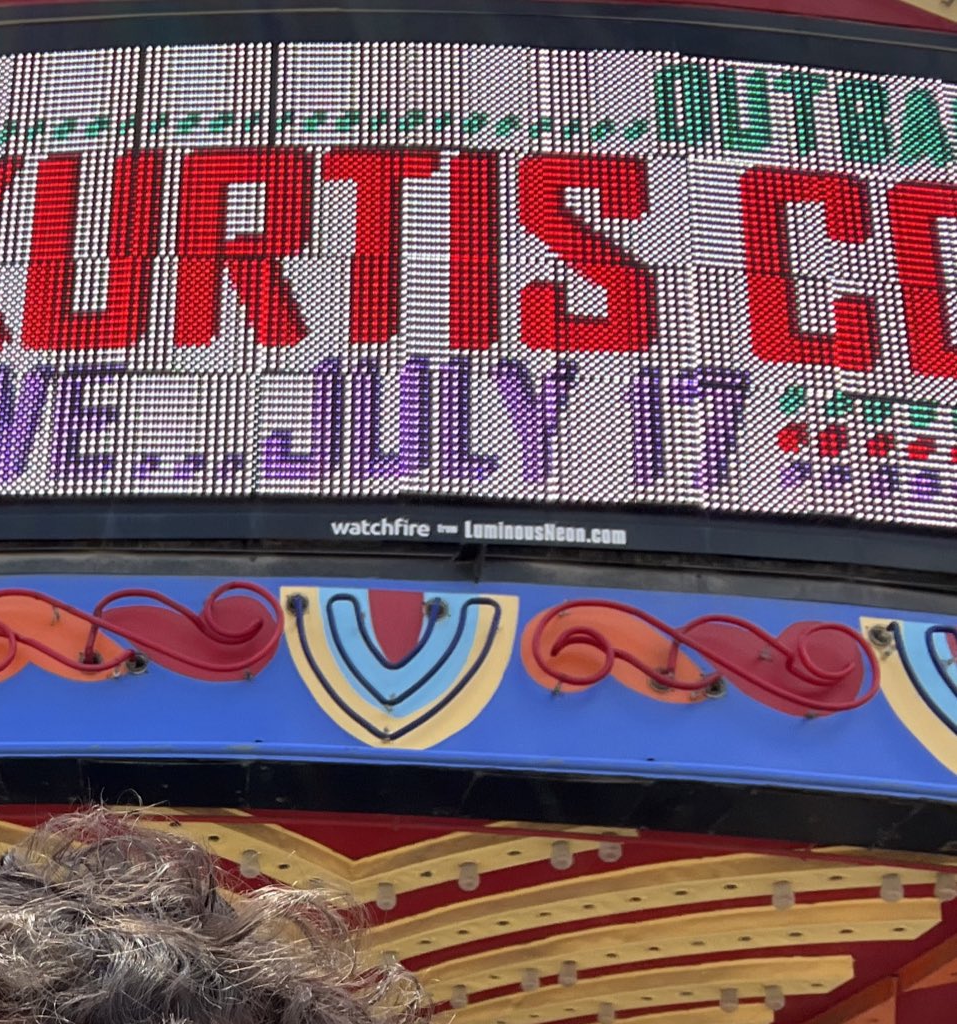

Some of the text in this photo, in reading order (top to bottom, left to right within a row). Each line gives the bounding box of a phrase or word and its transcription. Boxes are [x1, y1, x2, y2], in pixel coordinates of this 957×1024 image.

[652, 62, 957, 168] OUTBA
[632, 366, 750, 489] 17
[331, 517, 431, 538] watchfire
[464, 519, 628, 546] LuminousNeon.com
